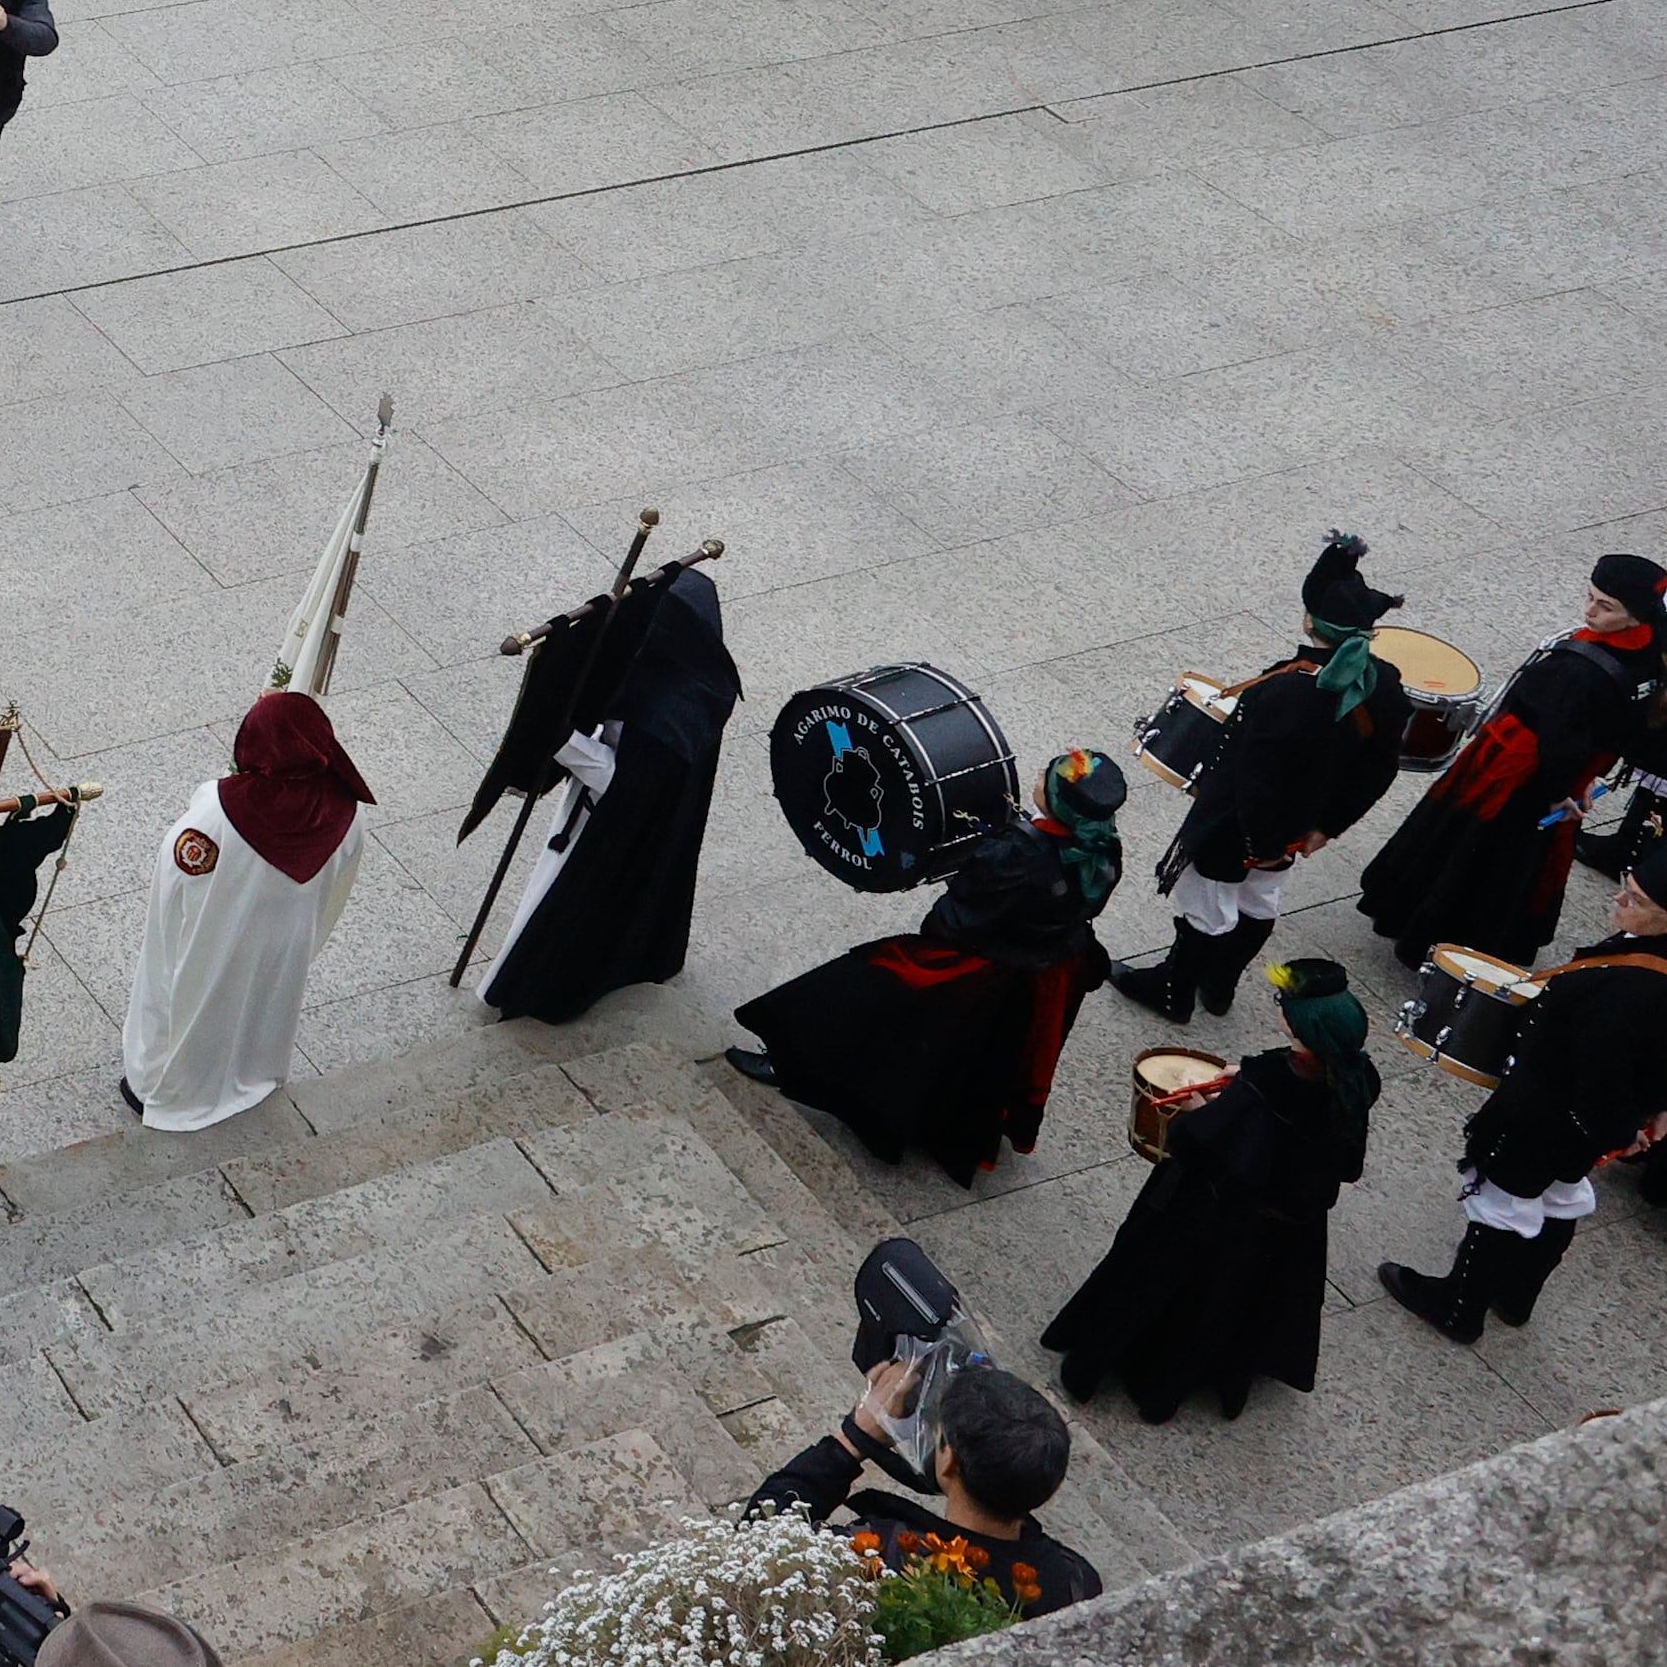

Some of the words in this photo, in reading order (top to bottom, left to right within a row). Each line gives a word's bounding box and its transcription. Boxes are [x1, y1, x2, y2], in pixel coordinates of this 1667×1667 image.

[793, 705, 852, 745] AGARIMO
[857, 713, 879, 736] DE
[881, 735, 925, 831] CATABOIS
[813, 821, 873, 871] FERROL
